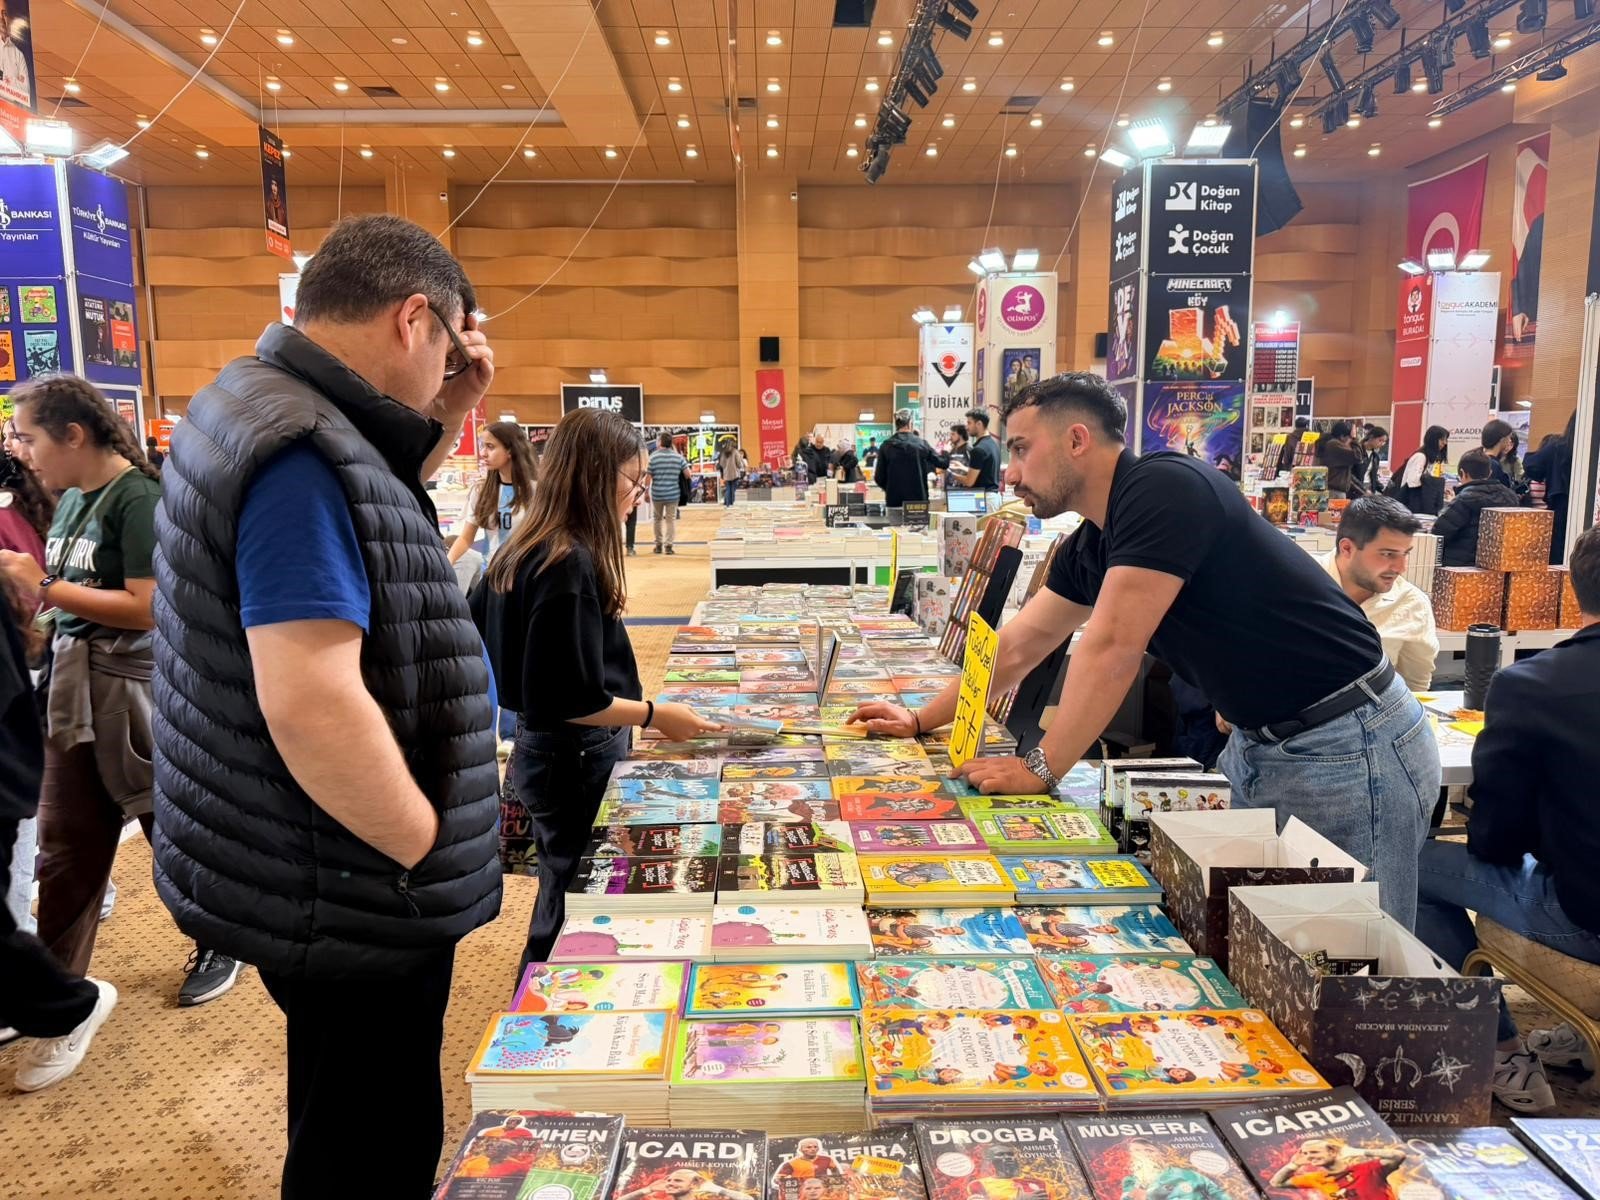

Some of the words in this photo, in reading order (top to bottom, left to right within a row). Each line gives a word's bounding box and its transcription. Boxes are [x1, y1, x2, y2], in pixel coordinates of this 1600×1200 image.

[1200, 184, 1241, 199] Doğan
[72, 206, 97, 221] TÜRKİYE
[1200, 200, 1233, 213] Kitap
[11, 210, 53, 219] BANKASI
[0, 232, 39, 243] Yayınları
[1193, 230, 1234, 243] Doğan
[1192, 243, 1230, 256] Çocuk
[1166, 278, 1232, 292] MINECRAFT
[927, 395, 970, 409] TÜBİTAK
[1167, 401, 1223, 418] JACKSON
[1354, 1023, 1396, 1031] BRACKEN
[1397, 1023, 1450, 1032] ALEXANDRA
[1378, 1099, 1417, 1112] SERİSİ
[1231, 1100, 1366, 1140] ICARDI
[1391, 1112, 1460, 1125] KARANLIK
[533, 1129, 609, 1143] MHEN
[929, 1127, 1057, 1146] DROGBA
[1077, 1120, 1208, 1139] MUSLERA
[1540, 1131, 1600, 1151] DŽ
[626, 1142, 754, 1160] ICARDI
